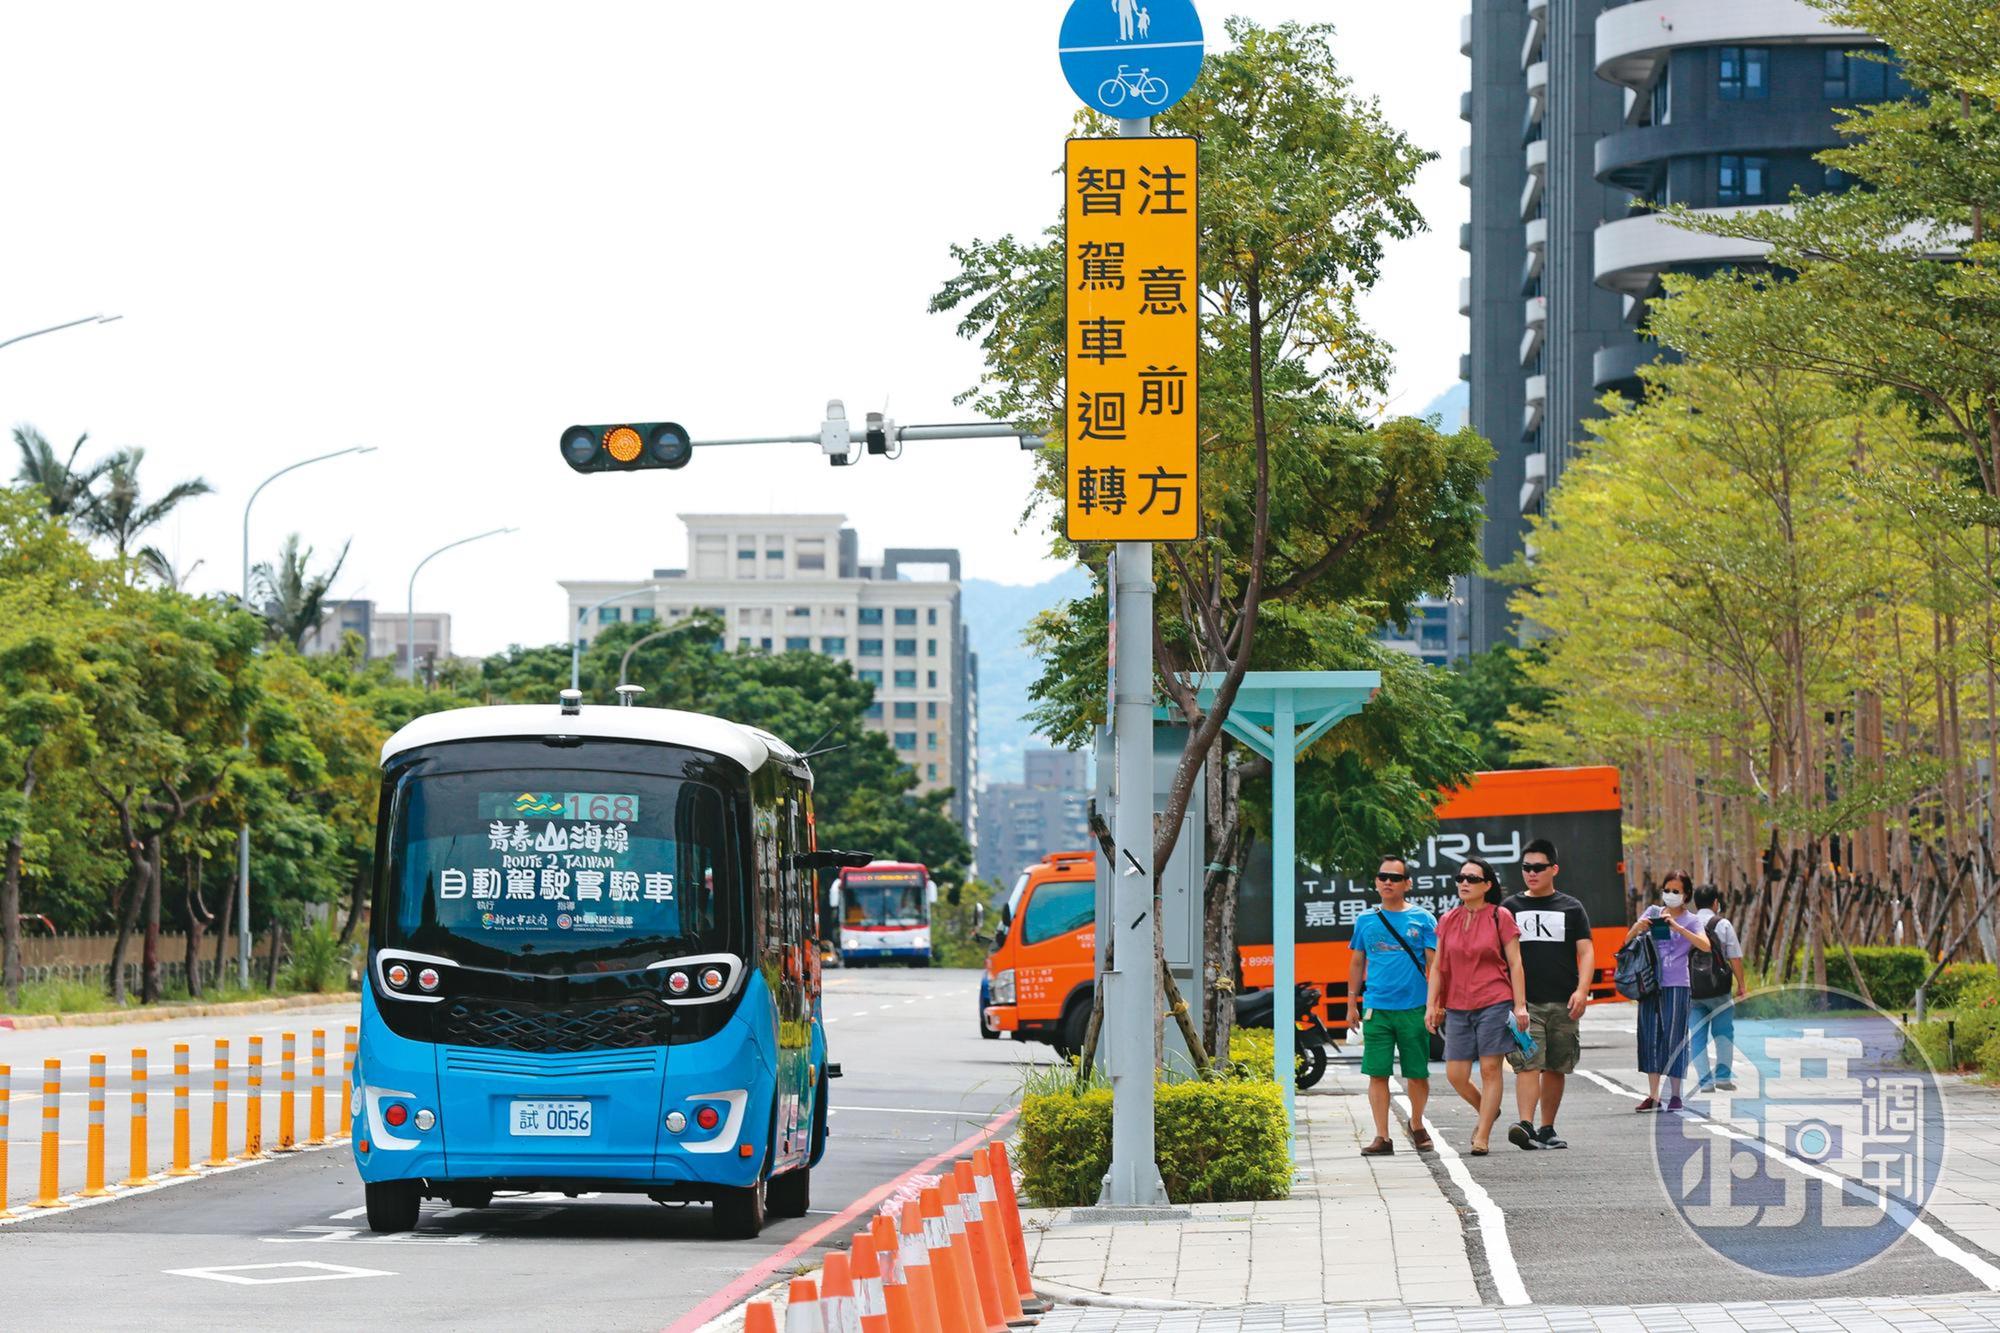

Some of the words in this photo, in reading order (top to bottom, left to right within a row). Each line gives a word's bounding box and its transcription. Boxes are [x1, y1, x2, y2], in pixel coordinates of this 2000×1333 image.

[1077, 165, 1127, 516] 智駕車迴轉
[1137, 165, 1188, 516] 注意前方
[569, 794, 635, 822] 168
[488, 820, 629, 854] 青春山海線
[503, 854, 542, 868] ROUTE
[547, 854, 559, 869] 2
[563, 854, 614, 869] TAIWAN
[440, 868, 674, 903] 自動駕駛實驗車
[1303, 880, 1336, 894] TJ
[494, 913, 549, 926] 新北市政府
[520, 1110, 539, 1129] 試
[547, 1110, 590, 1130] 0056
